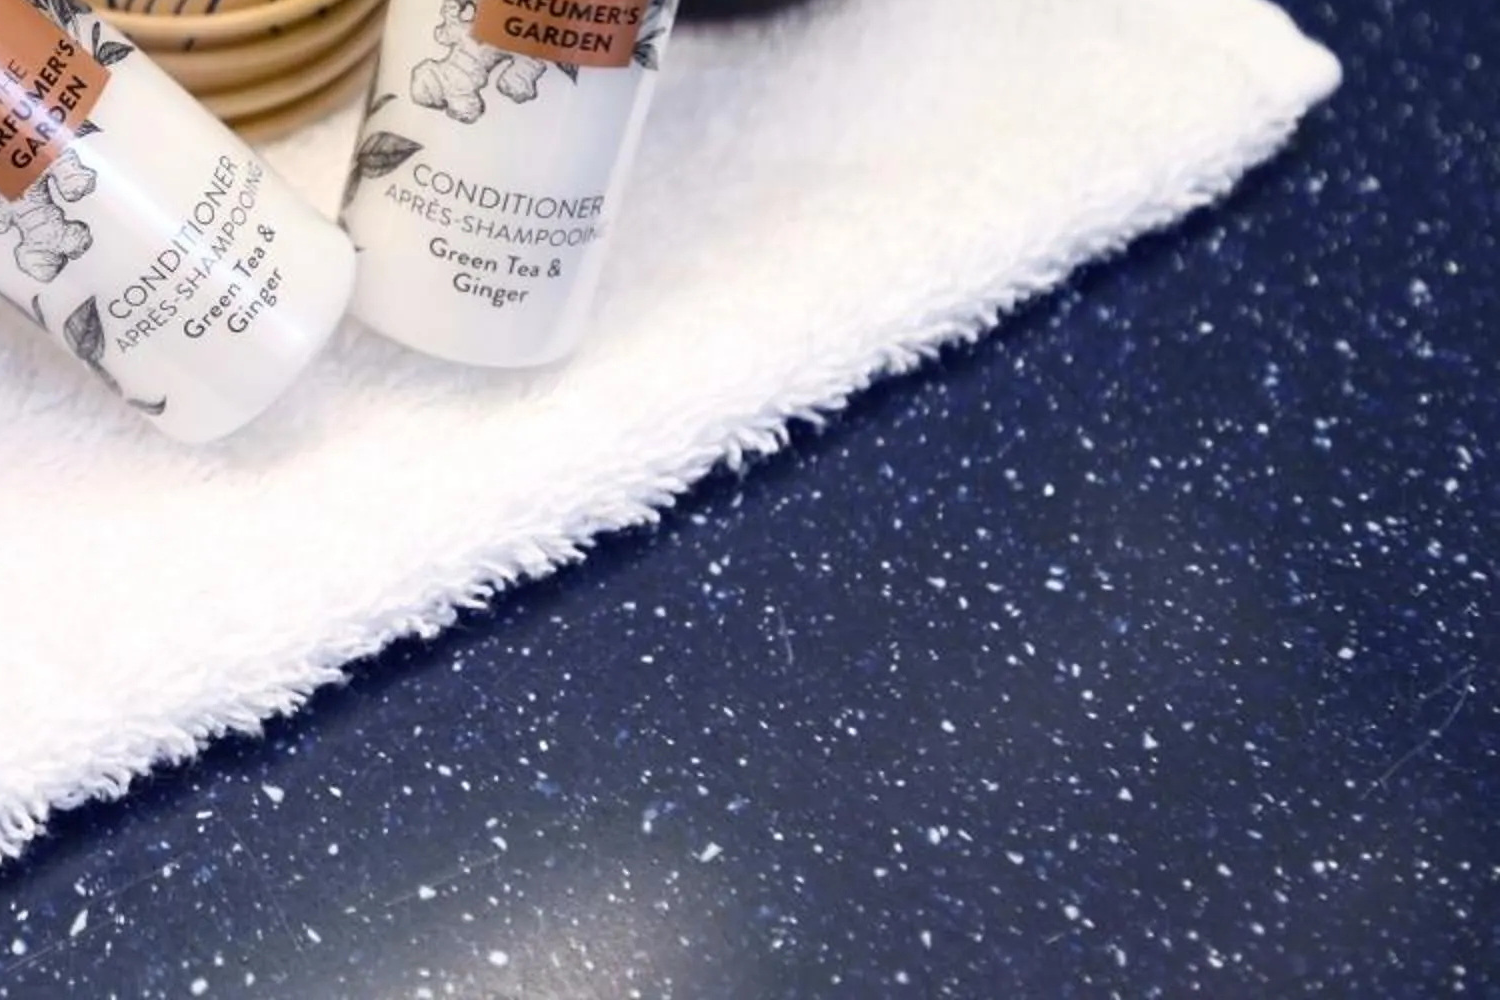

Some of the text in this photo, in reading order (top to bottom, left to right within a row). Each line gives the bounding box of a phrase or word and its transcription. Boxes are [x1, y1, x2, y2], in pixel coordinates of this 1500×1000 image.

[503, 15, 614, 54] GARDEN
[10, 75, 89, 170] GARDEN
[412, 163, 604, 219] CONDITIONER
[108, 154, 239, 320] CONDITIONER
[428, 237, 563, 278] Green Tea &
[182, 223, 277, 339] Green Tea &
[226, 267, 284, 336] Ginger
[452, 273, 528, 308] Ginger
